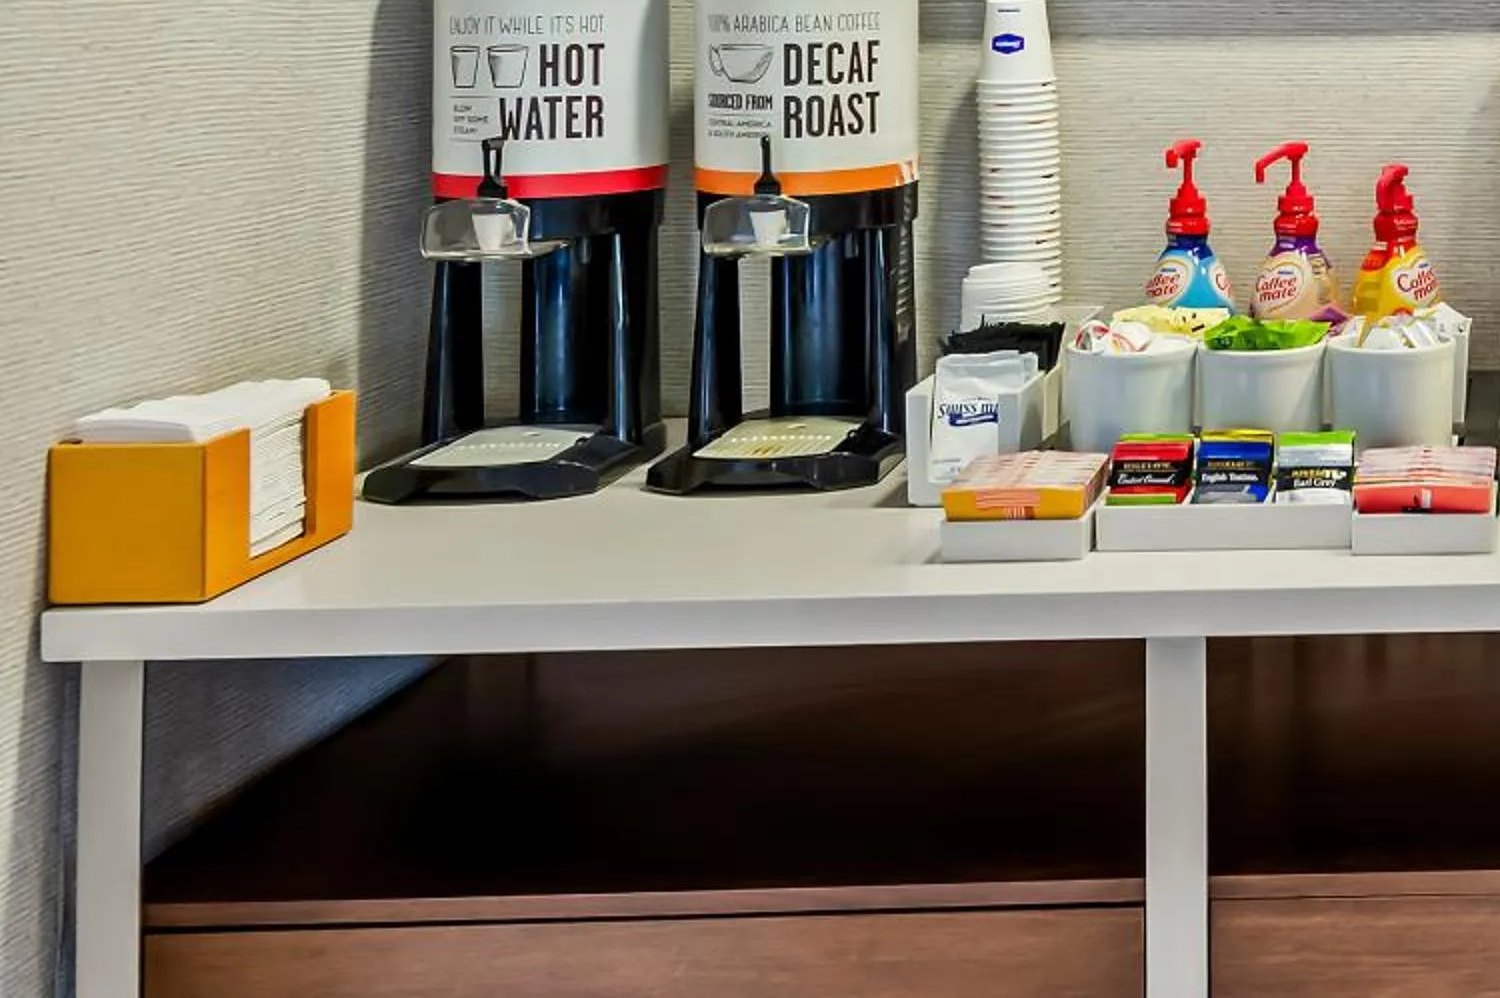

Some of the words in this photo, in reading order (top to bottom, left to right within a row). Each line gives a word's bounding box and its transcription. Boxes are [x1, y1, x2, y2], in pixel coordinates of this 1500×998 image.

[450, 15, 481, 35] ENJOY
[484, 15, 496, 35] IT
[500, 15, 545, 35] WHILE
[551, 15, 574, 35] IT'S
[580, 14, 605, 34] HOT
[733, 13, 789, 34] ARABICA
[795, 13, 834, 33] BEAN
[837, 11, 881, 32] COFFEE
[539, 42, 605, 88] HOT
[783, 39, 881, 87] DECAF
[745, 93, 773, 111] FROM
[499, 95, 604, 141] WATER
[783, 91, 881, 139] ROAST
[1256, 272, 1297, 293] Coffee
[1259, 287, 1298, 302] mate
